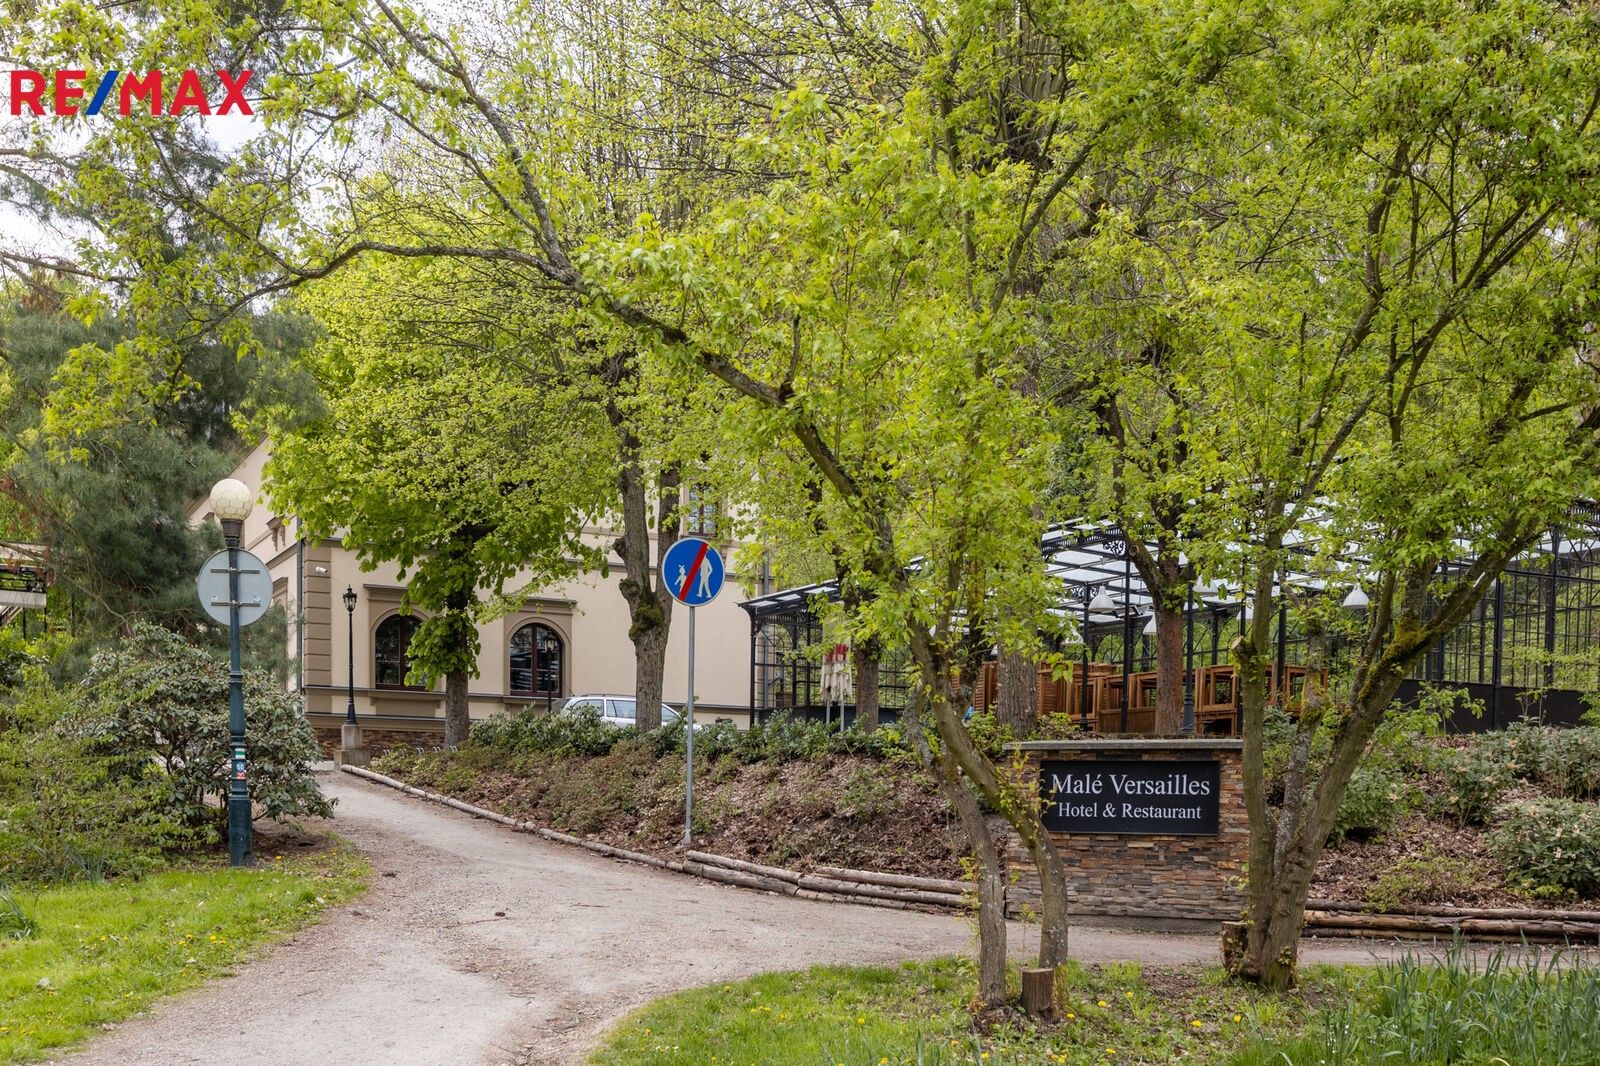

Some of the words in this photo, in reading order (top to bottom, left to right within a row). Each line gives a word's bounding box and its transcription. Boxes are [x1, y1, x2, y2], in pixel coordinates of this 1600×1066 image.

[1052, 773, 1103, 794] Malé
[1109, 774, 1210, 795] Versailles
[1058, 802, 1098, 818] Hotel
[1102, 802, 1117, 818] &
[1122, 803, 1202, 819] Restaurant
